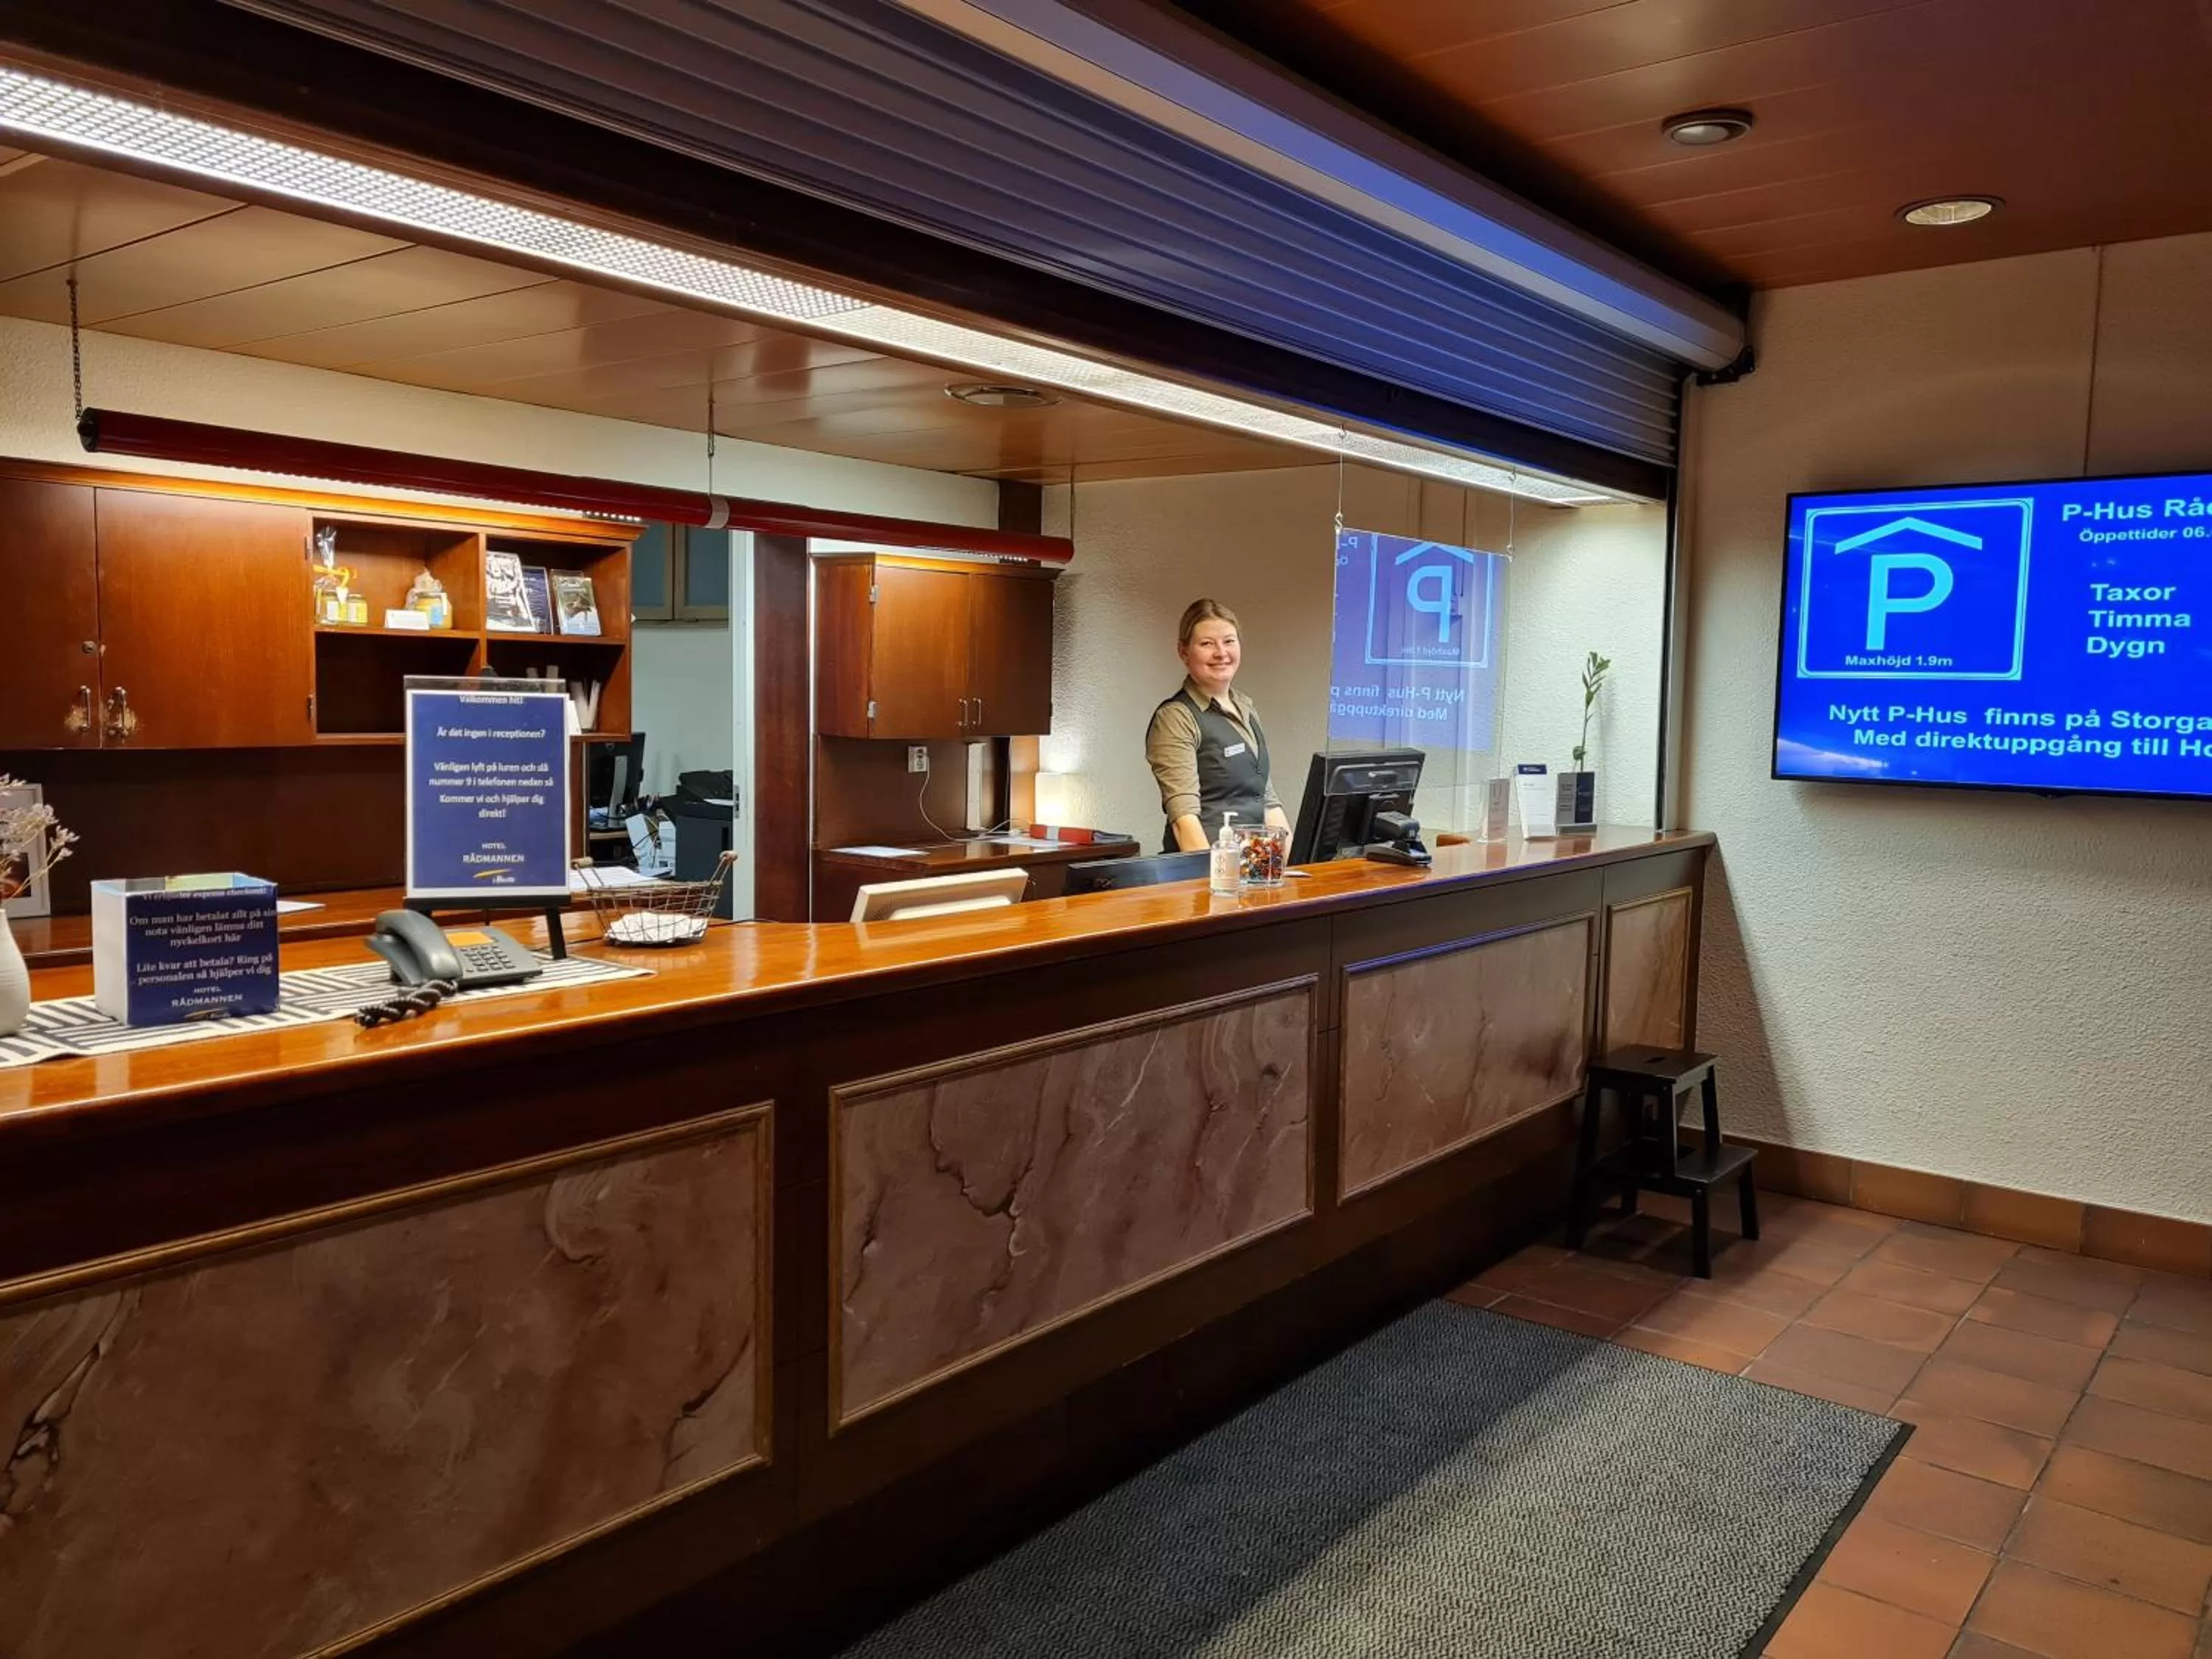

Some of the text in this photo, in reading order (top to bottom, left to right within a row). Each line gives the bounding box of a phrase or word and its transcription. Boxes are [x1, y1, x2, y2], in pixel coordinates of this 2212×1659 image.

[2062, 501, 2153, 521] P-Hus
[2079, 527, 2177, 543] Öppettider
[2090, 582, 2176, 602] Taxor
[1865, 552, 1954, 650] P
[2088, 610, 2191, 628] Timma
[2087, 636, 2166, 658] Dygn
[1845, 654, 1953, 669] Maxhöjd 1.9m
[1829, 704, 2212, 734] Nytt P-Hus finns på Storga
[448, 727, 463, 737] det
[1854, 728, 1907, 746] Med
[1915, 731, 2122, 759] direktuppgång
[2131, 737, 2168, 756] till
[434, 762, 549, 773] Vänligen lyft på luren och slå
[428, 777, 465, 787] nummer
[465, 777, 472, 787] 9
[478, 776, 518, 787] telefonen
[518, 777, 543, 787] nedan
[544, 777, 554, 787] så
[439, 793, 544, 805] Kommer vi och hjälper dig
[479, 808, 507, 818] direkt!
[462, 852, 524, 862] RÅDMANNEN
[129, 916, 149, 925] Om
[151, 916, 174, 925] man
[176, 914, 195, 922] har
[195, 911, 230, 921] betalat
[232, 909, 248, 919] allt
[249, 908, 261, 919] på
[145, 919, 264, 936] nota vänligen lämna ditt
[170, 933, 242, 948] nyckelkort här
[136, 952, 273, 973] Lite kvar att betala? Ring på
[138, 971, 194, 986] personalen
[195, 969, 207, 979] så
[209, 967, 243, 981] hjälper
[246, 966, 254, 975] vi
[193, 986, 221, 994] HOTEL
[171, 994, 243, 1007] RÅDMANNEN
